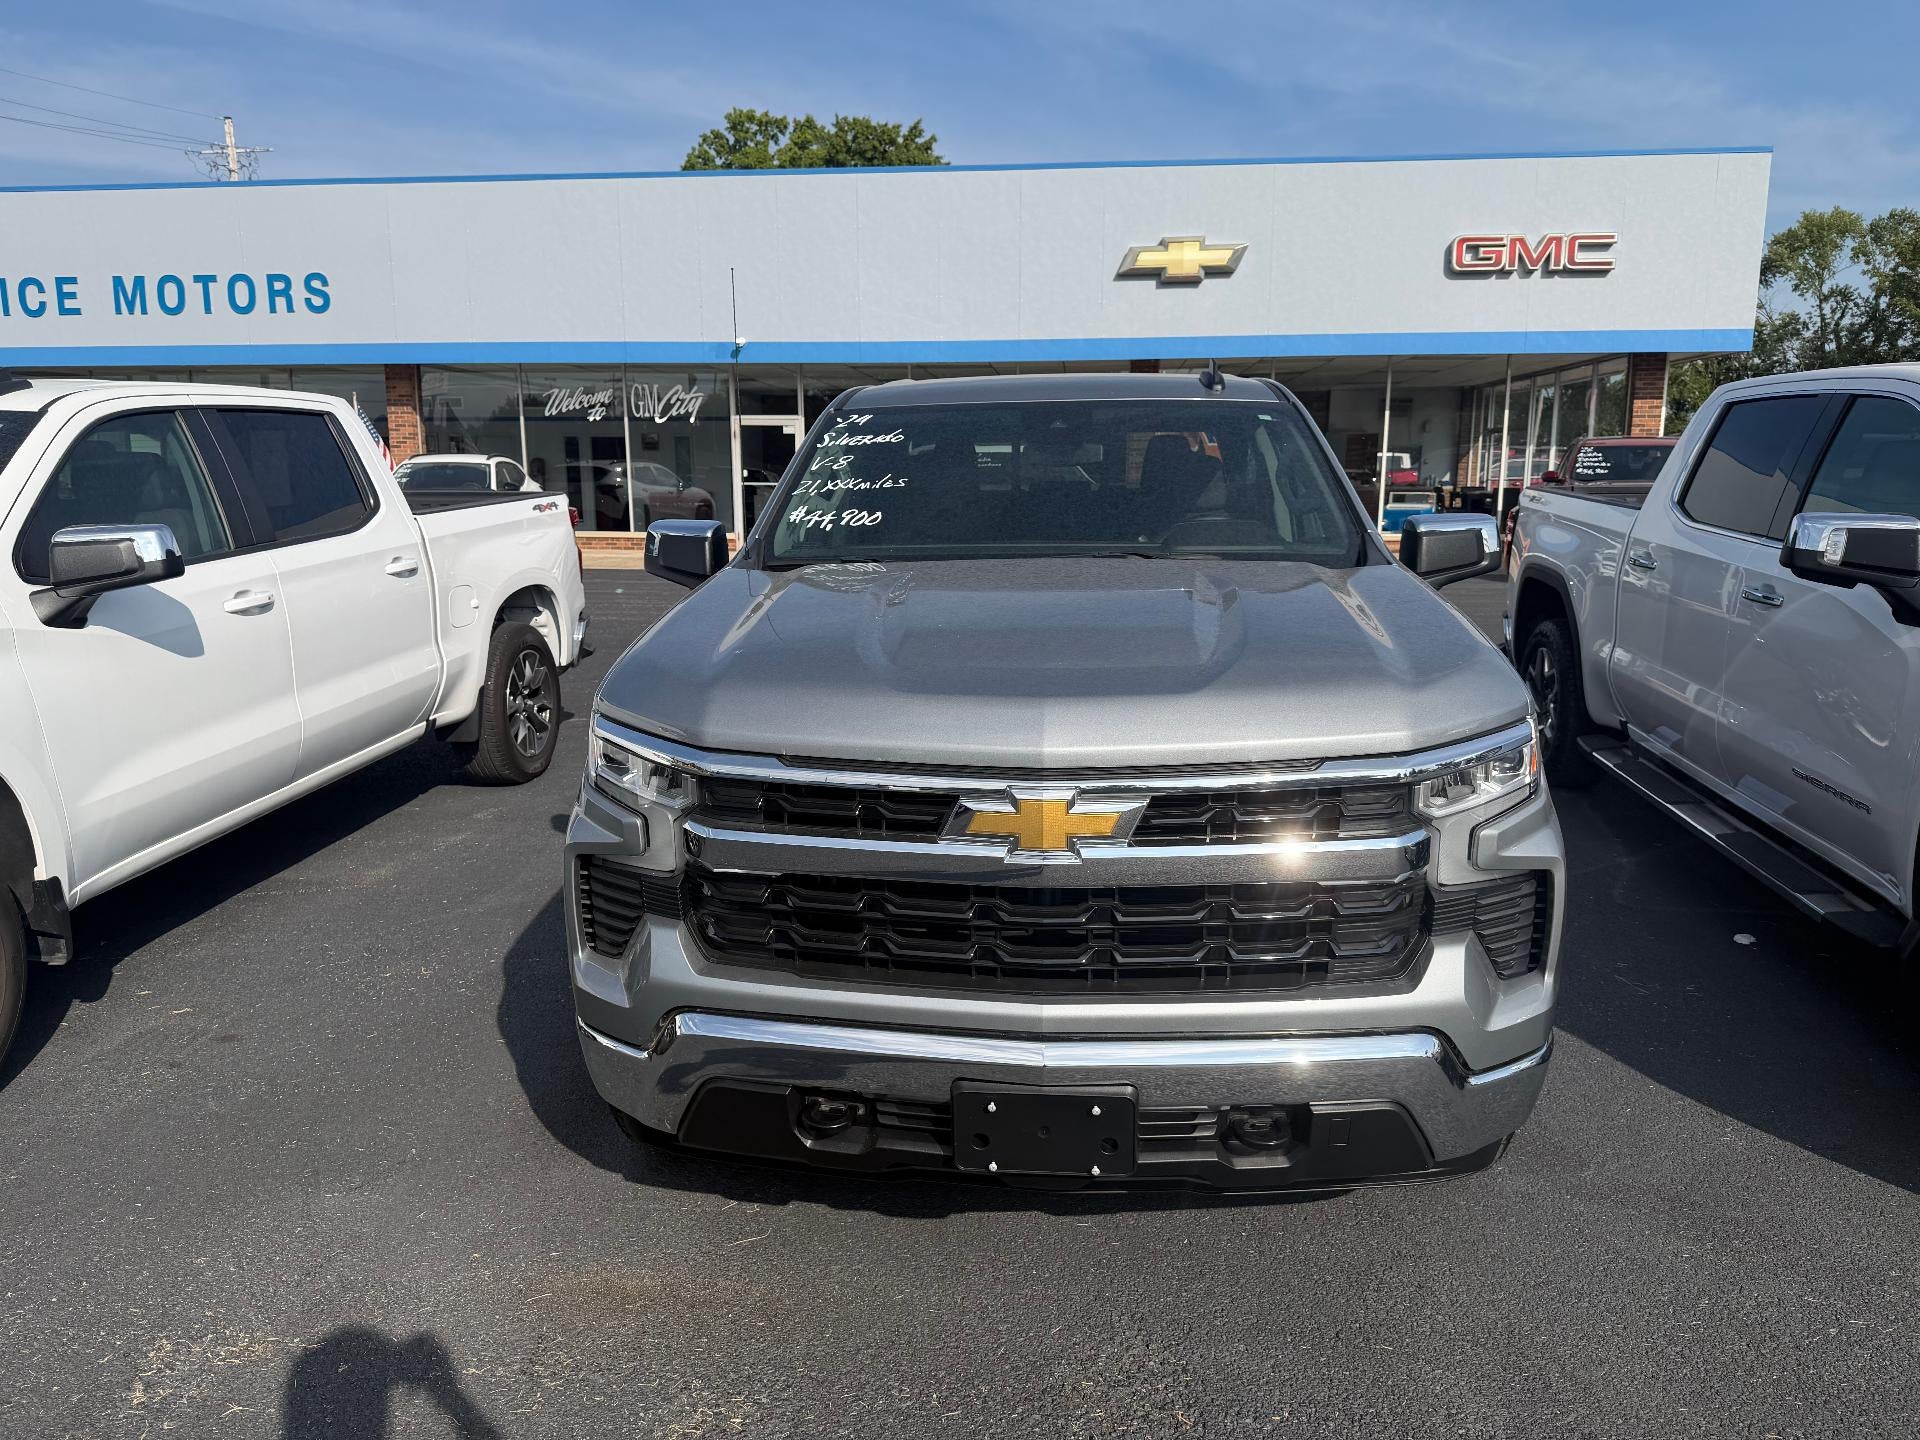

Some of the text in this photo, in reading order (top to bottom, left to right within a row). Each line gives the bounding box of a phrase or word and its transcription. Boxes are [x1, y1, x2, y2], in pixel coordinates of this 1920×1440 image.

[1451, 231, 1618, 272] GMC
[111, 272, 332, 316] MOTORS
[543, 386, 614, 417] Welcome
[586, 402, 607, 422] to
[811, 455, 854, 471] V-8
